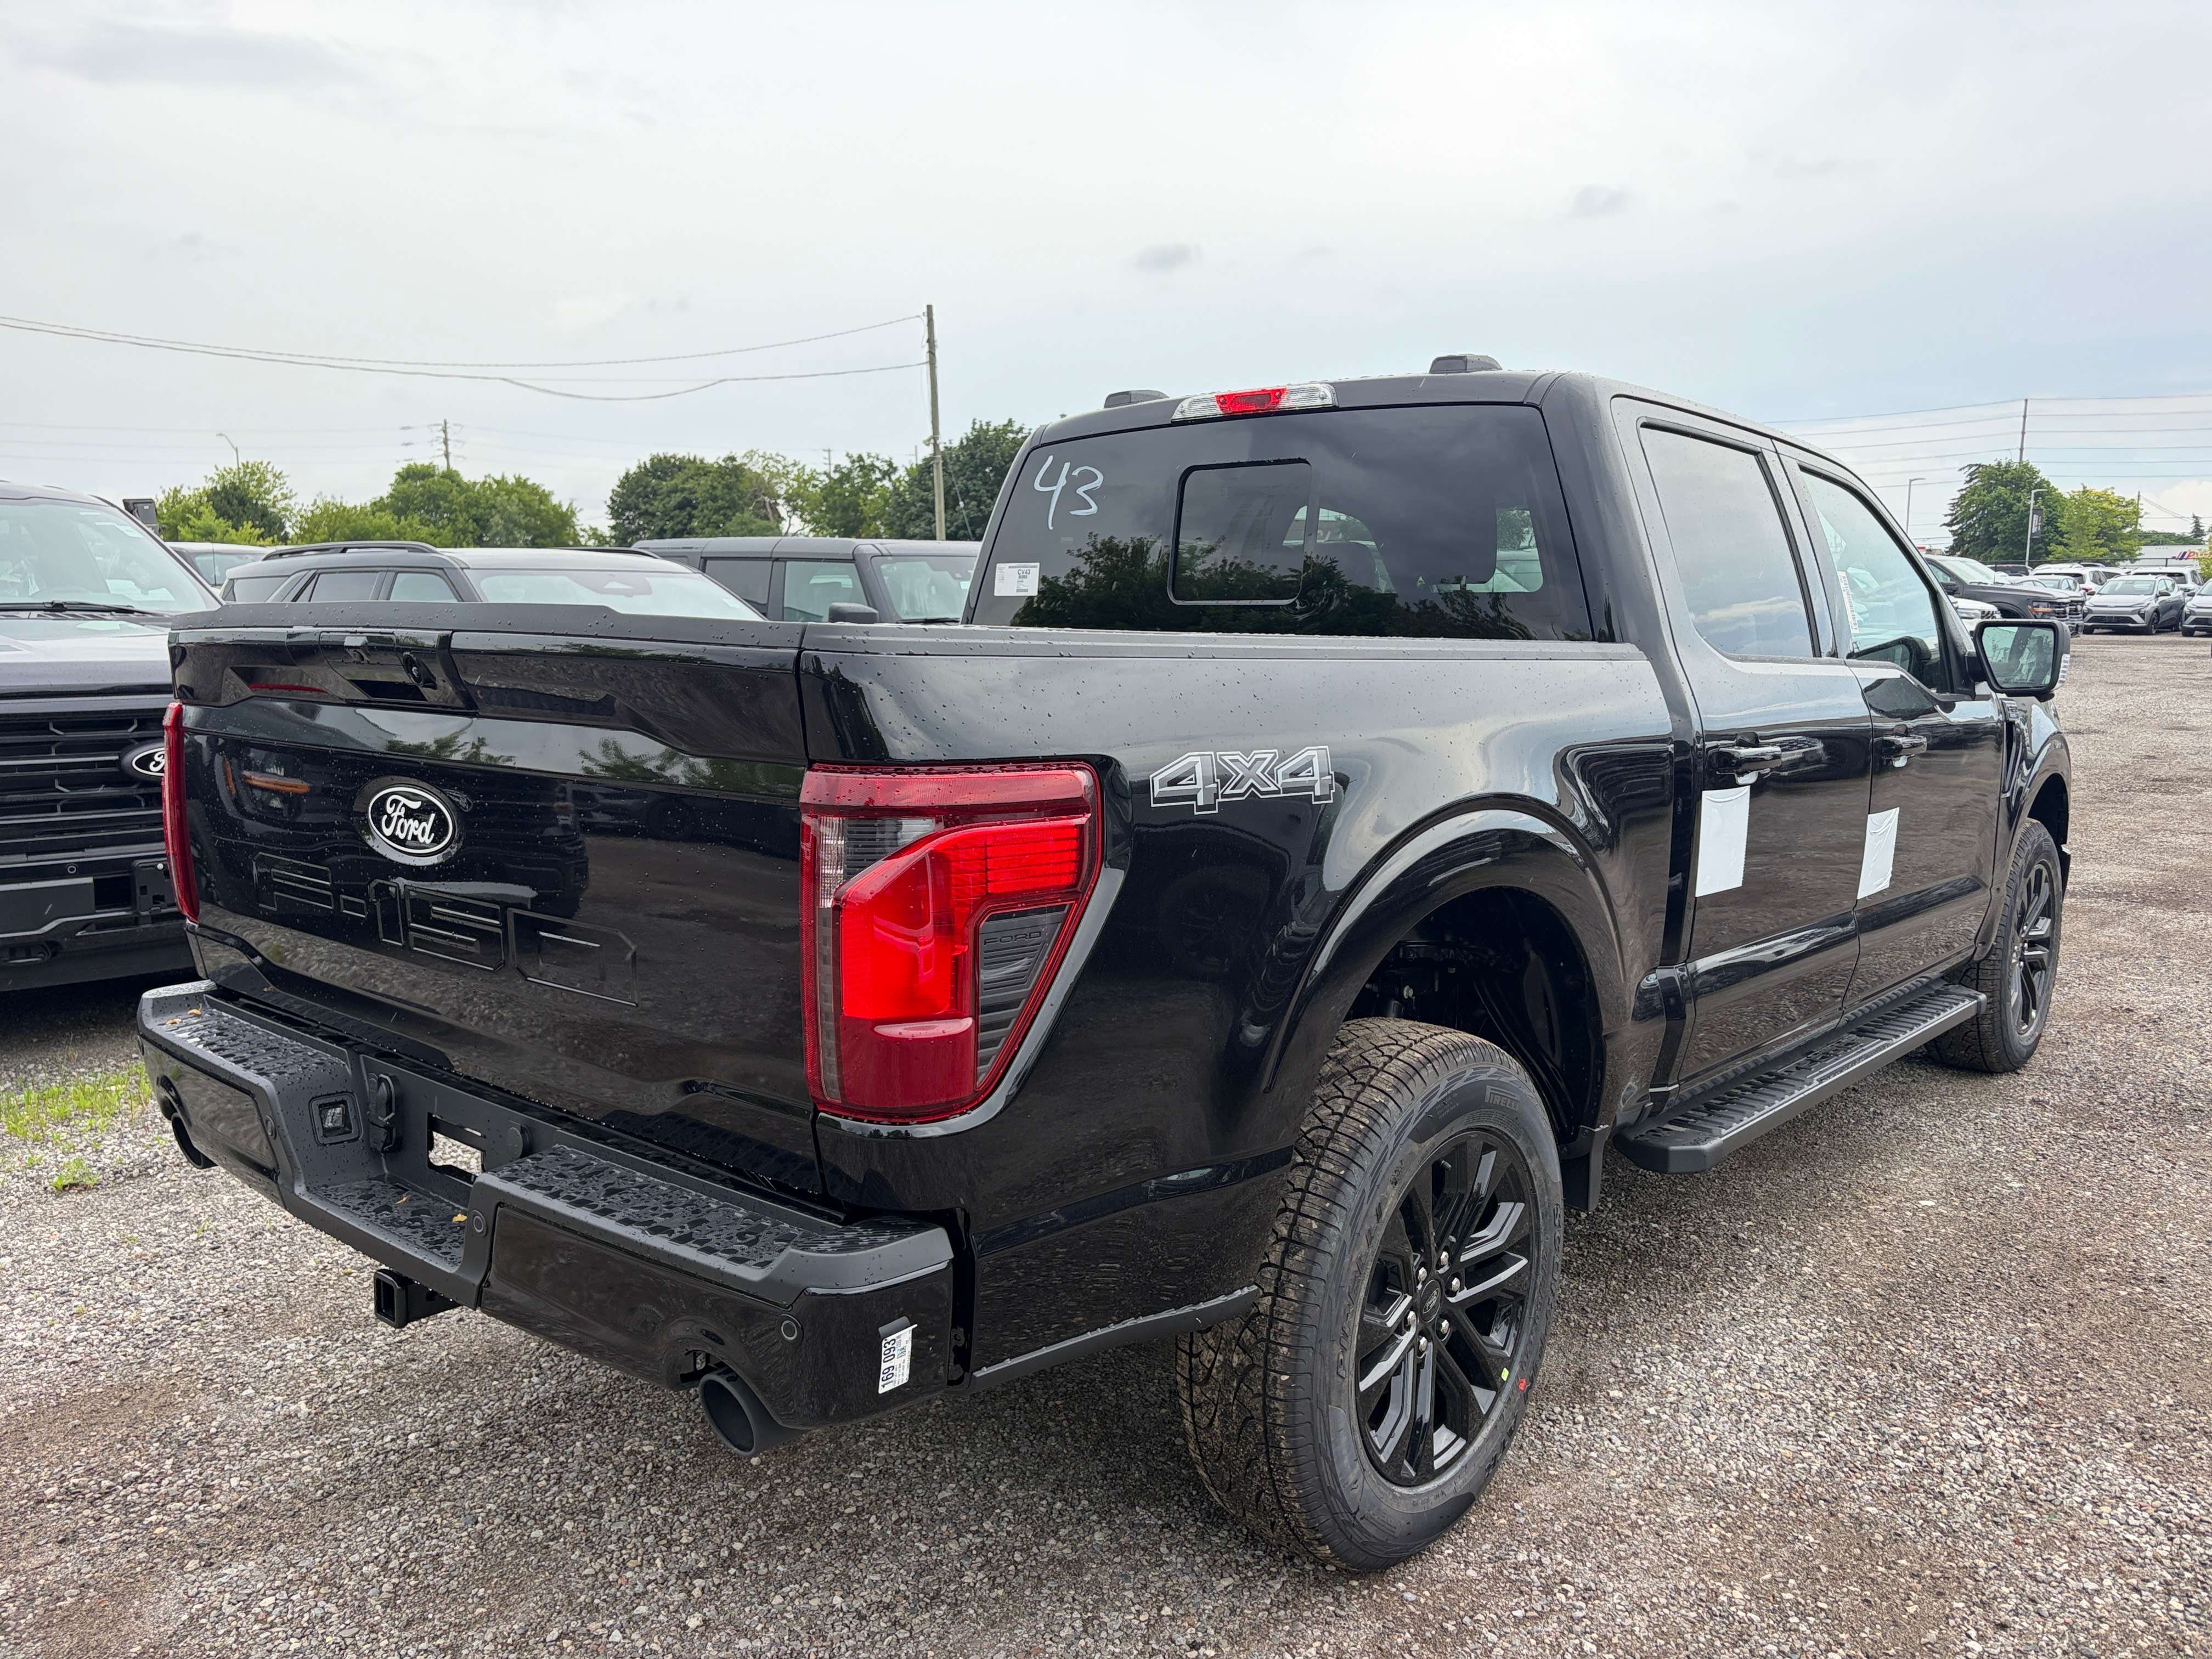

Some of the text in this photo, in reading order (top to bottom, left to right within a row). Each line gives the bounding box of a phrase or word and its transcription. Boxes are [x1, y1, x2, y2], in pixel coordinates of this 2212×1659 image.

[1034, 455, 1104, 530] 43
[382, 794, 436, 844] Ford
[252, 852, 639, 1006] F-150
[984, 931, 1041, 945] FORD
[1484, 1085, 1520, 1112] PIRELLI
[881, 1338, 896, 1389] 169 093
